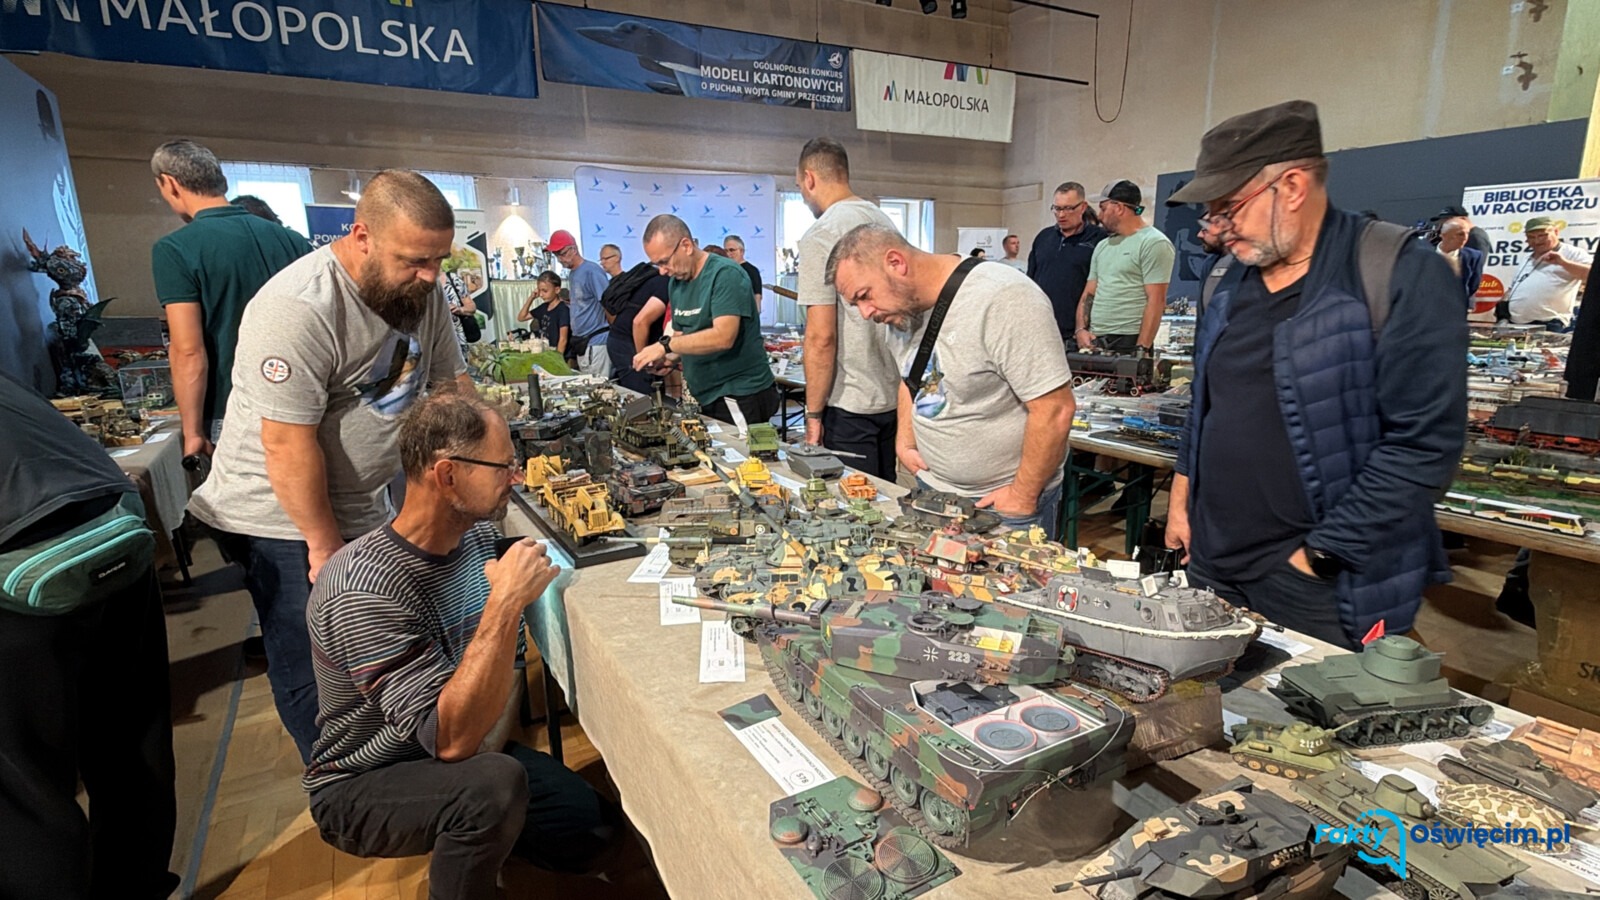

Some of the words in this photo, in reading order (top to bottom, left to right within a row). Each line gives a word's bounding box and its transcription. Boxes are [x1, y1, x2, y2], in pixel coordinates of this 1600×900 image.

[101, 0, 475, 66] MAŁOPOLSKA
[700, 65, 749, 82] MODELI
[753, 71, 843, 93] KARTONOWYCH
[753, 60, 810, 75] OGÓLNOPOLSKI
[811, 67, 843, 79] KONKURS
[701, 81, 708, 90] O
[709, 84, 743, 94] PUCHAR
[744, 86, 770, 97] WÓJTA
[771, 89, 797, 99] GMINY
[797, 92, 844, 104] PRZECISZÓW
[904, 88, 989, 113] MAŁOPOLSKA
[1483, 185, 1584, 203] BIBLIOTEKA
[1472, 204, 1490, 215] W
[1492, 197, 1598, 215] RACIBORZU
[948, 650, 971, 664] 223
